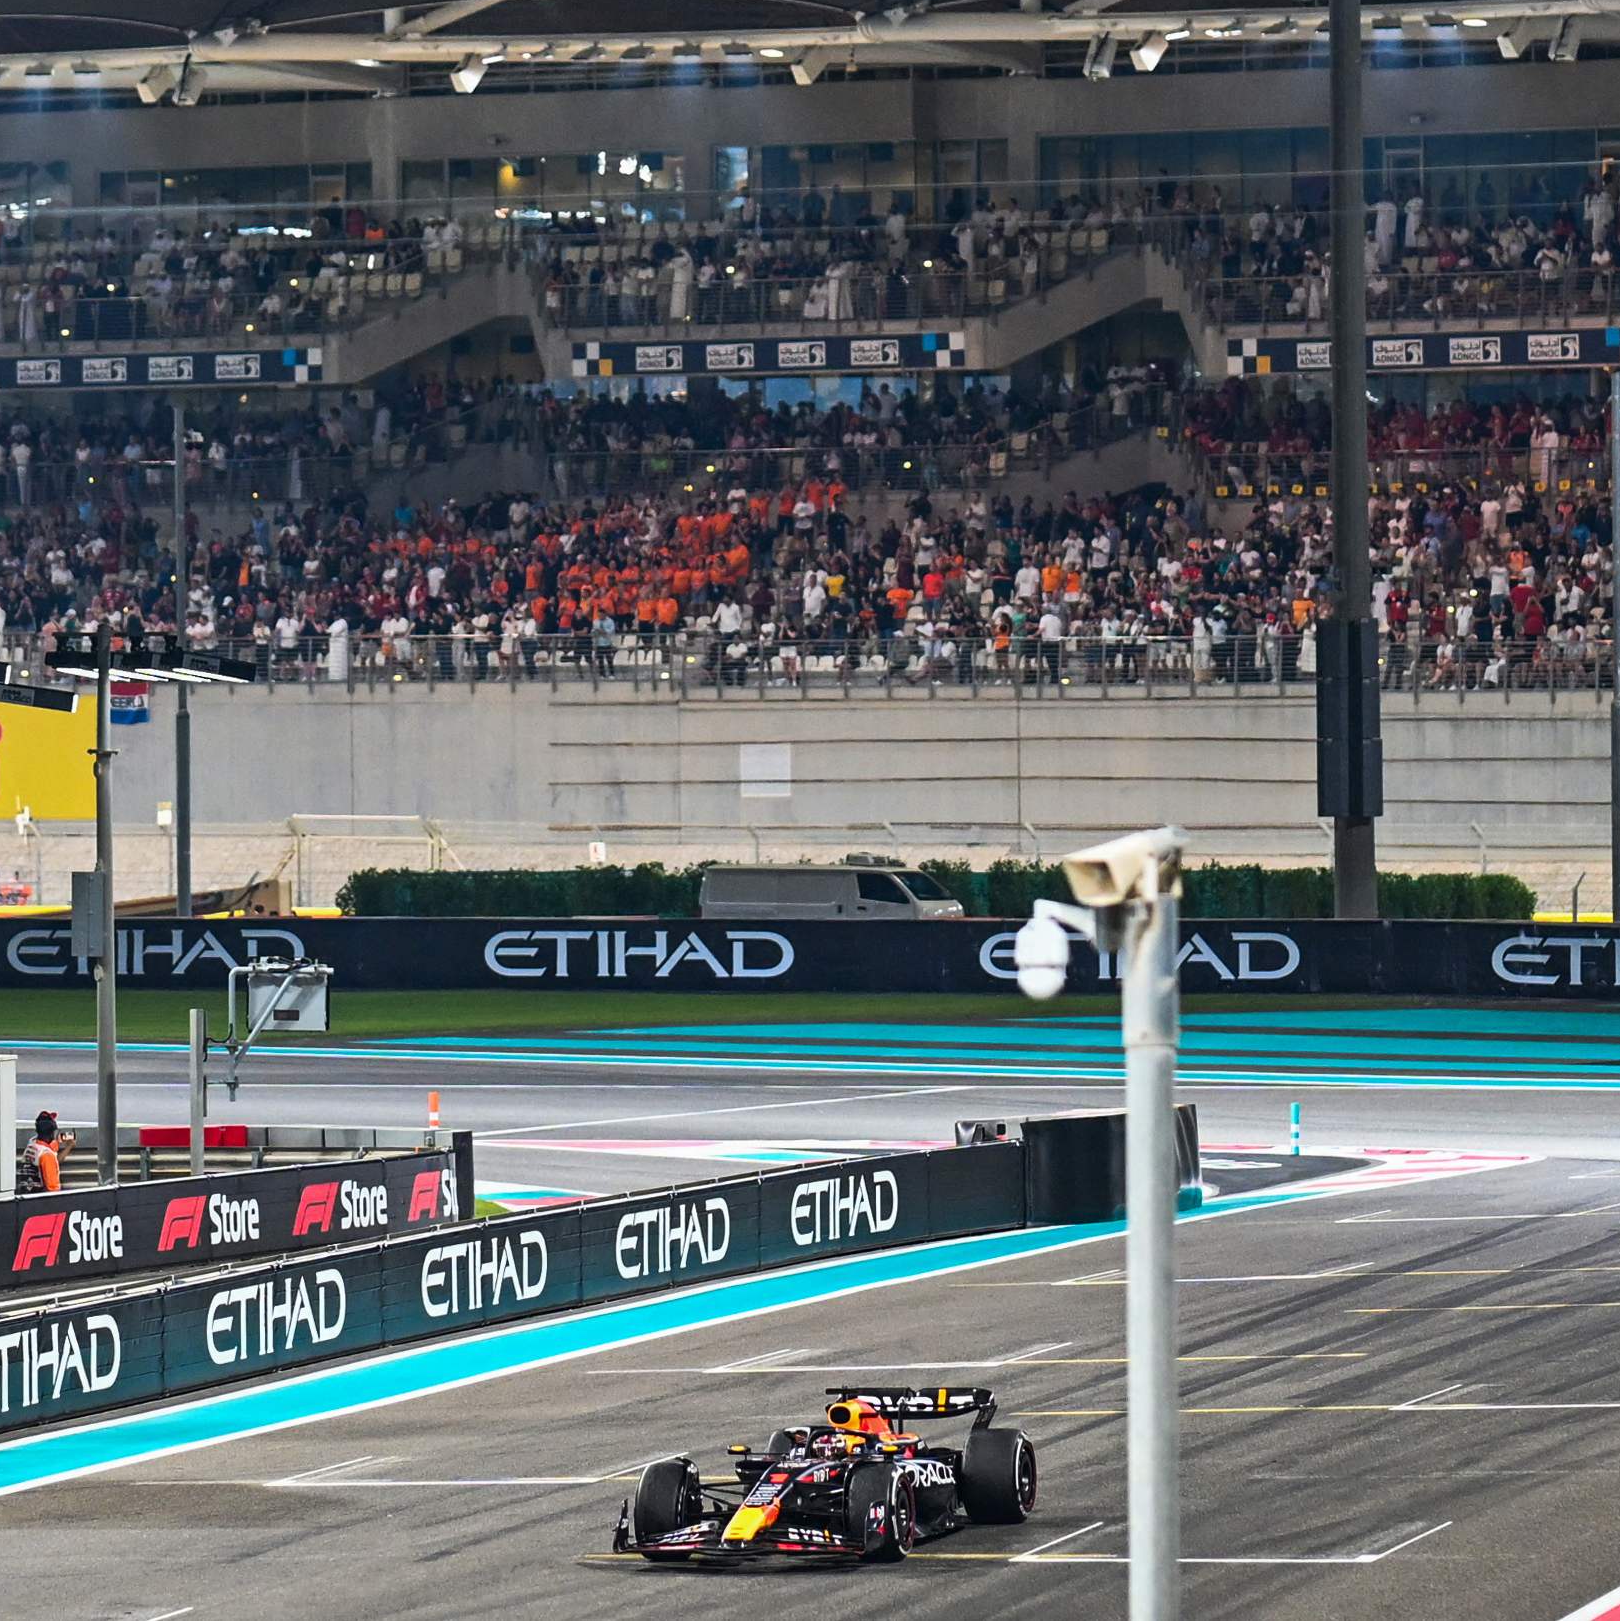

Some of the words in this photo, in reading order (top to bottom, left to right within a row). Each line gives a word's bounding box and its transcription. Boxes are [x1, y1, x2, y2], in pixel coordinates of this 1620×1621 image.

[484, 930, 795, 978] ETIHAD
[12, 1212, 67, 1271] F1
[68, 1210, 124, 1264] Store
[158, 1195, 207, 1252] F1
[208, 1193, 260, 1245] Store
[293, 1181, 340, 1236] F1
[340, 1179, 388, 1230] Store
[614, 1196, 731, 1279] ETIHAD
[790, 1170, 899, 1246] ETIHAD
[421, 1230, 548, 1317] ETIHAD
[206, 1268, 346, 1365] ETIHAD
